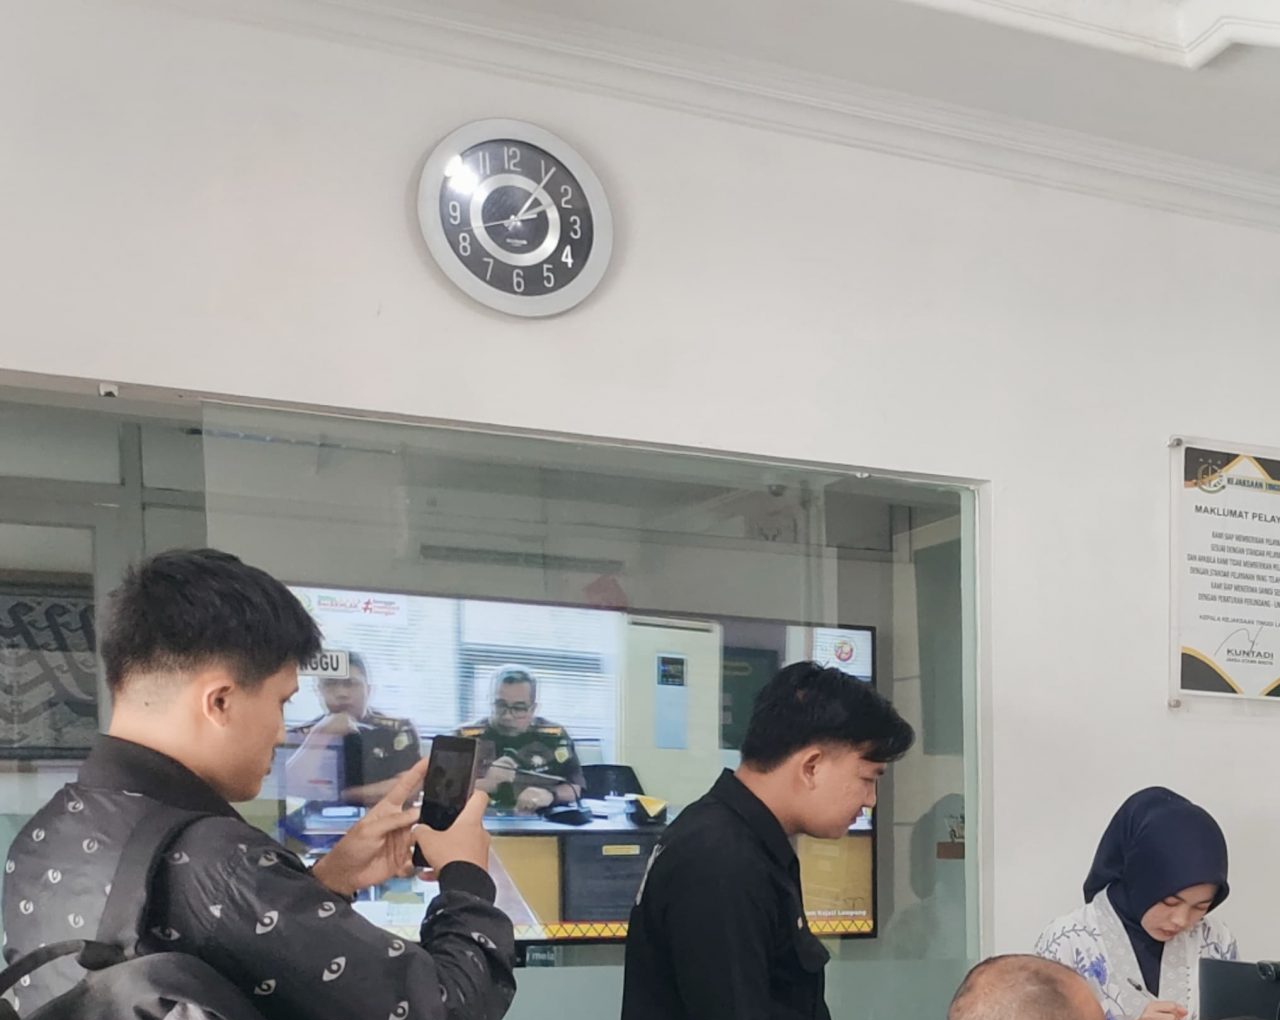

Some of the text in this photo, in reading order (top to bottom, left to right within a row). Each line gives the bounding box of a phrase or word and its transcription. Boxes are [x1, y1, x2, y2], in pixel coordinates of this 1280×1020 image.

[479, 151, 490, 175] 11
[504, 146, 522, 171] 12
[560, 185, 572, 208] 2
[449, 201, 461, 225] 9
[569, 216, 581, 239] 3
[458, 232, 471, 256] 8
[561, 244, 574, 268] 4
[483, 258, 494, 281] 7
[512, 269, 525, 292] 6
[543, 264, 554, 287] 5
[1227, 477, 1263, 489] KEJAKSAAN
[1195, 504, 1249, 520] MAKLUMAT
[1226, 648, 1274, 659] KUNTADI
